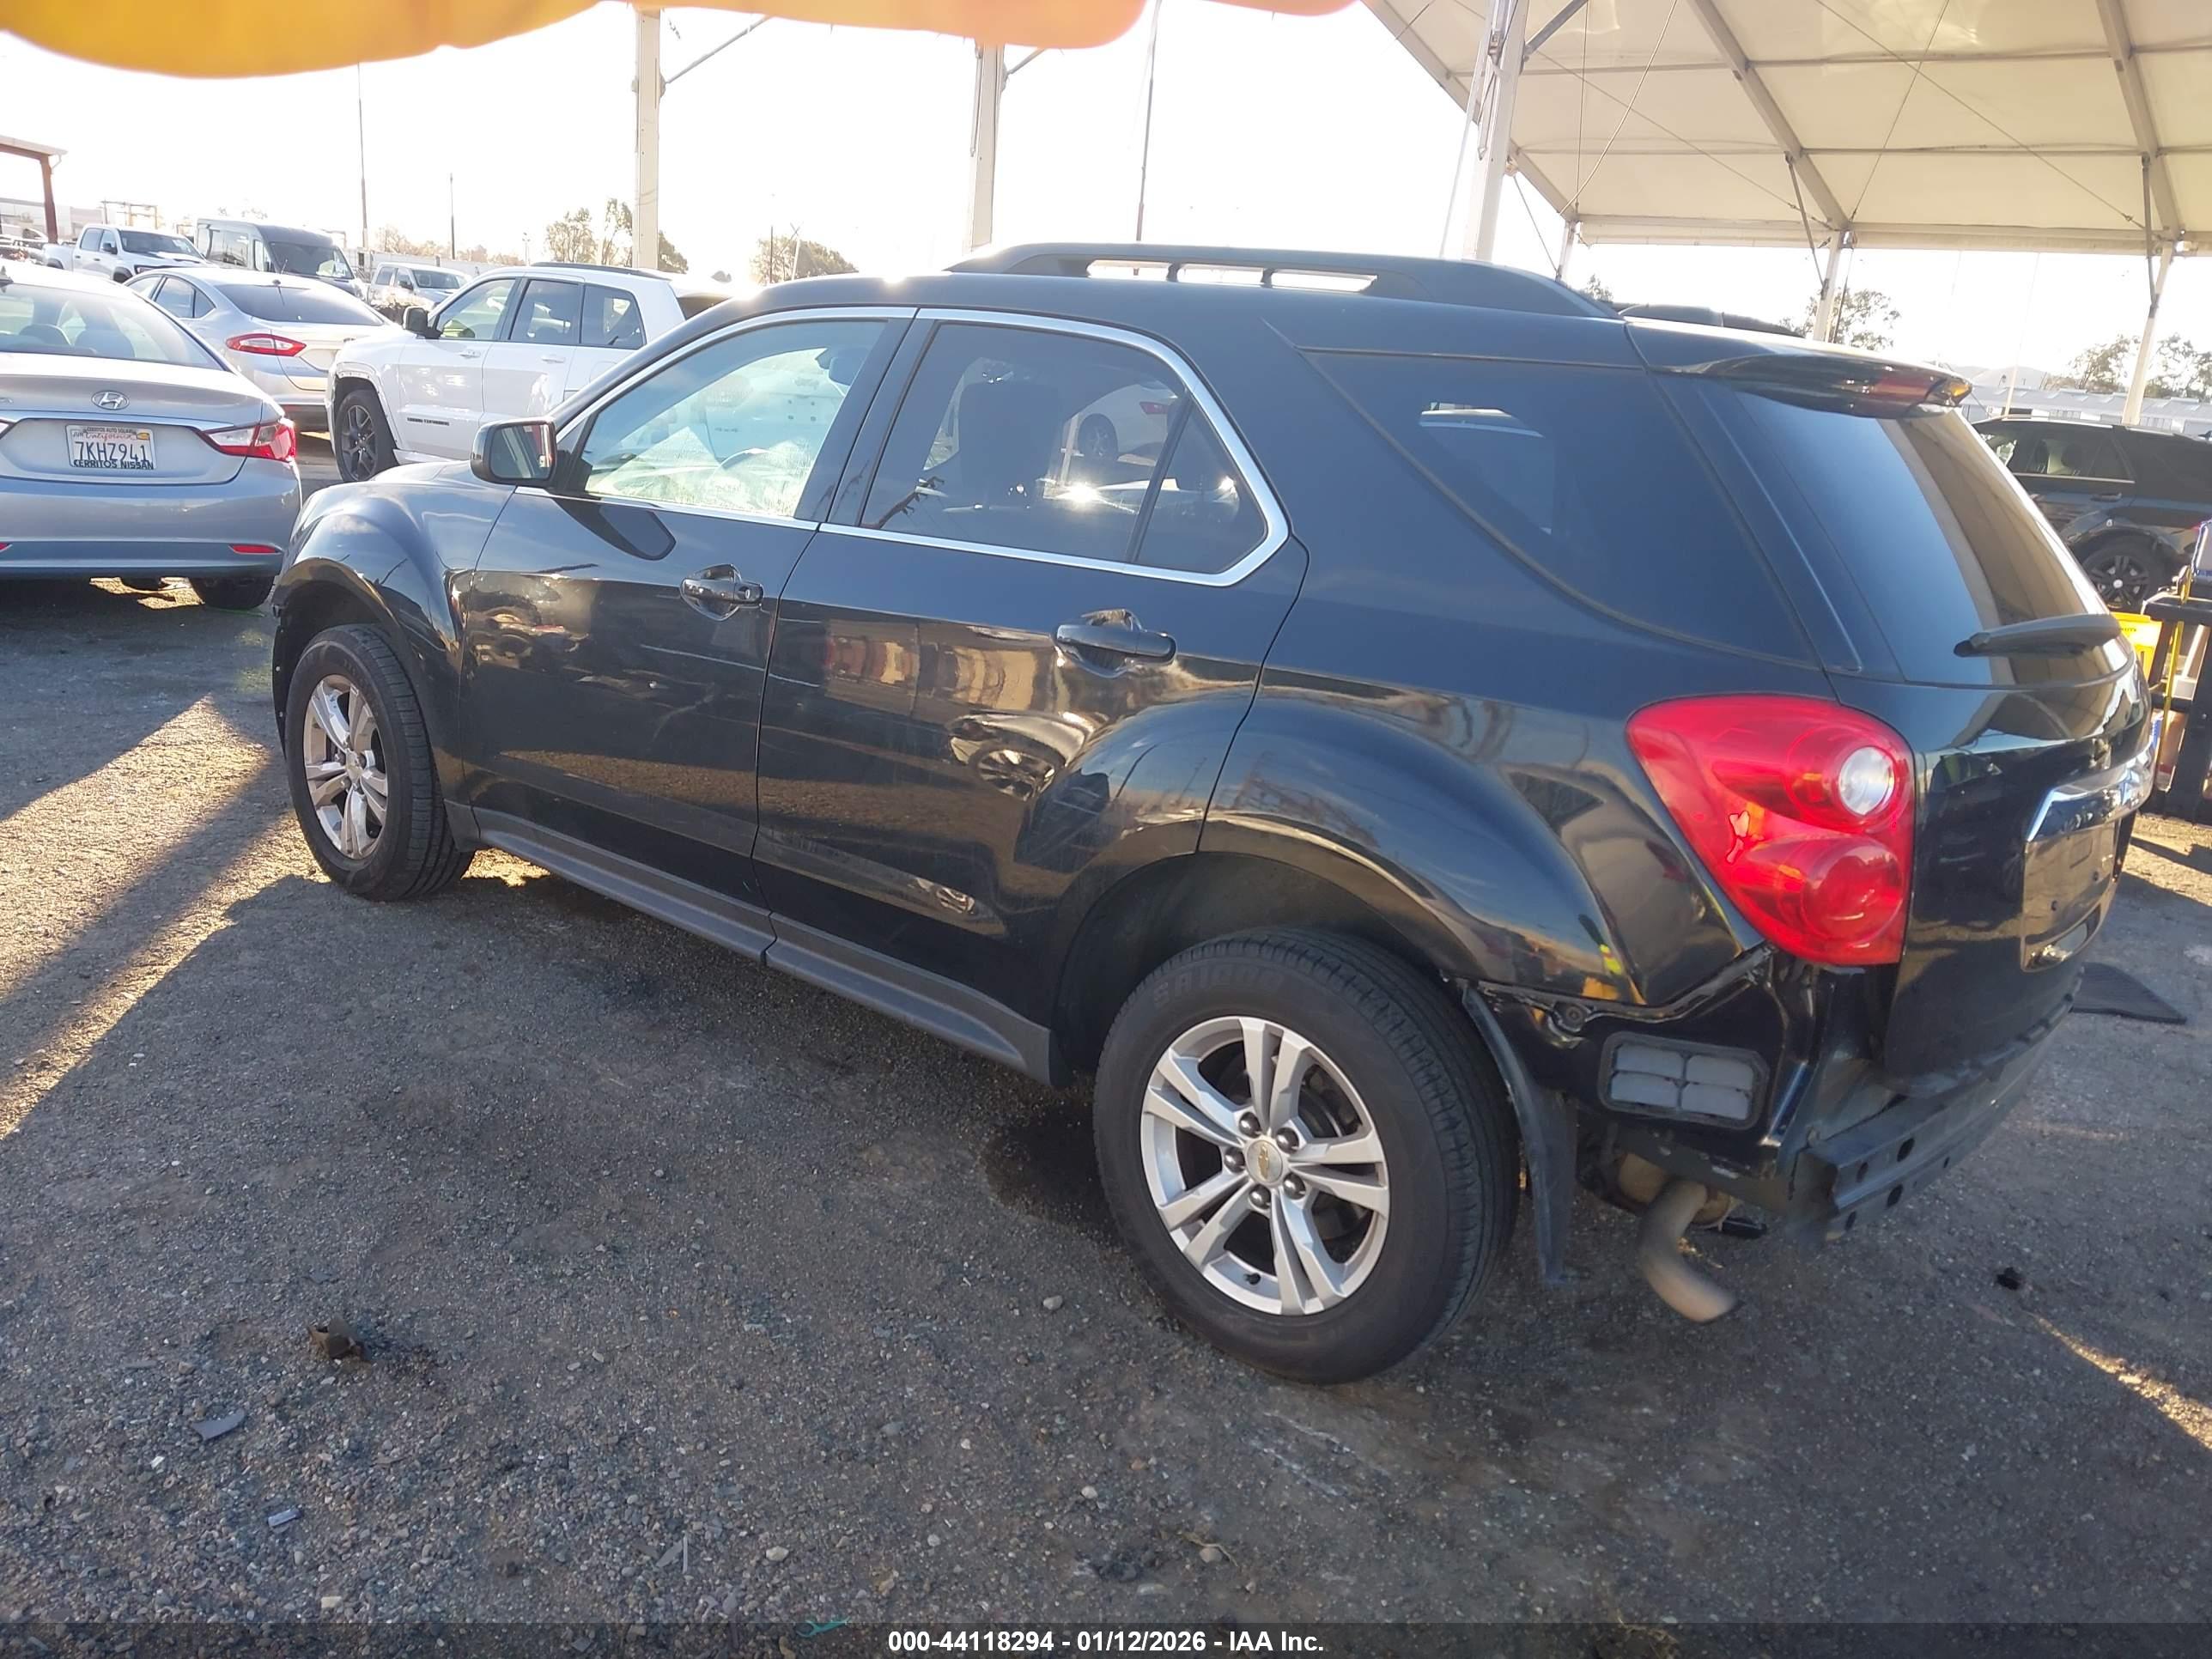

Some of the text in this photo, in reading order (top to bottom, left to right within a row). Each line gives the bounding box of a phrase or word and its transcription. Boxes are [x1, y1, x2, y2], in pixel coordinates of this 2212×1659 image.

[75, 441, 147, 461] 7KHZ941
[74, 459, 154, 470] CERRITOS NISSAN
